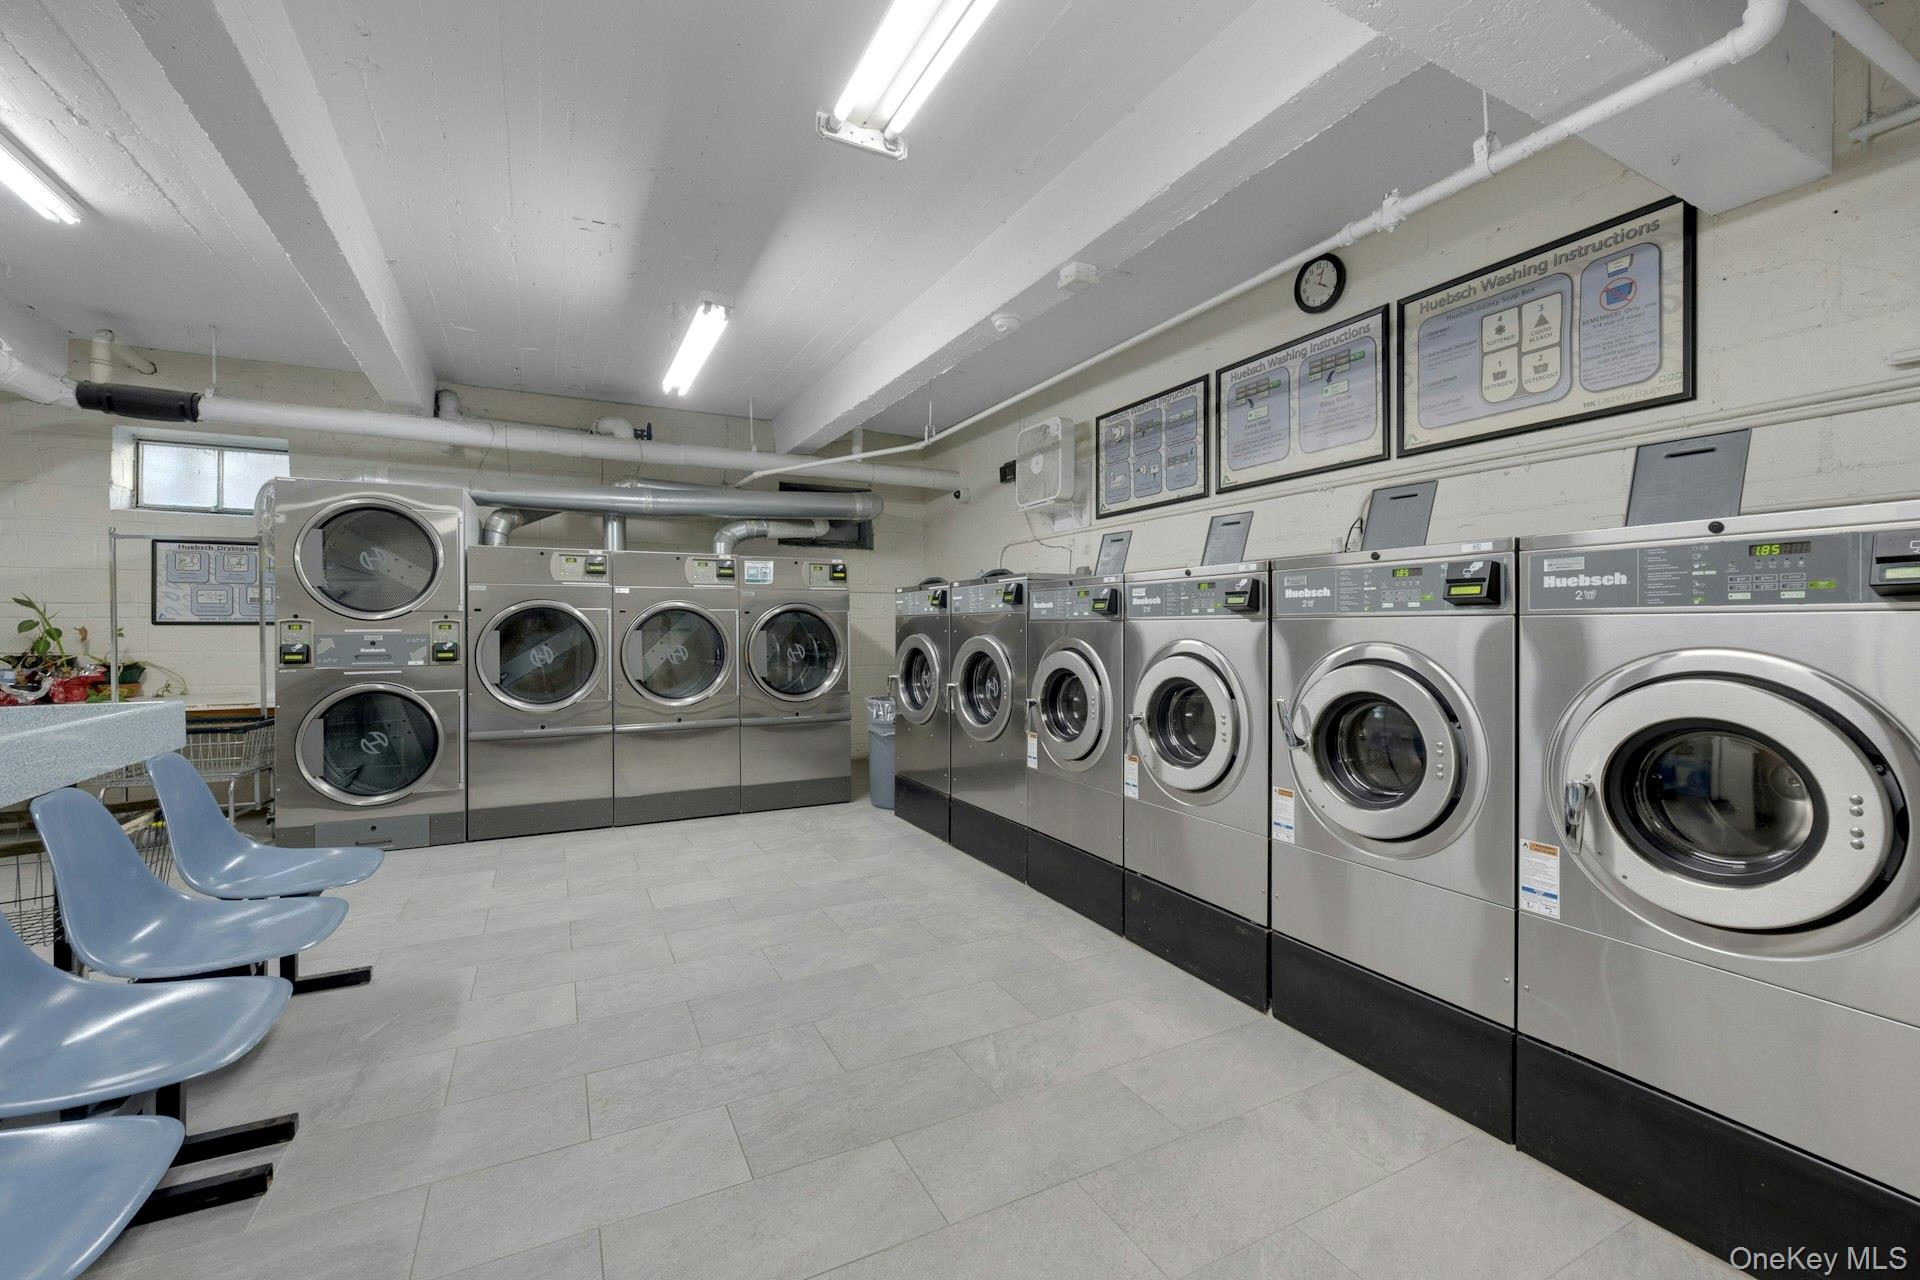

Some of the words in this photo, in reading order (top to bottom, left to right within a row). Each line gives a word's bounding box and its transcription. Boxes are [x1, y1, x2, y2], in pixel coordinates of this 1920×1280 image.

[1419, 285, 1477, 314] Huebsch
[1479, 259, 1548, 292] Washing
[1553, 219, 1660, 266] Instructions
[1521, 287, 1535, 296] Box
[1230, 361, 1266, 382] Huebsch
[1267, 346, 1308, 369] Washing
[1310, 323, 1371, 354] Instructions
[1543, 572, 1628, 588] Huebsch
[1285, 587, 1331, 598] Huebsch
[1575, 590, 1583, 600] 2
[1132, 596, 1161, 605] Huebsch
